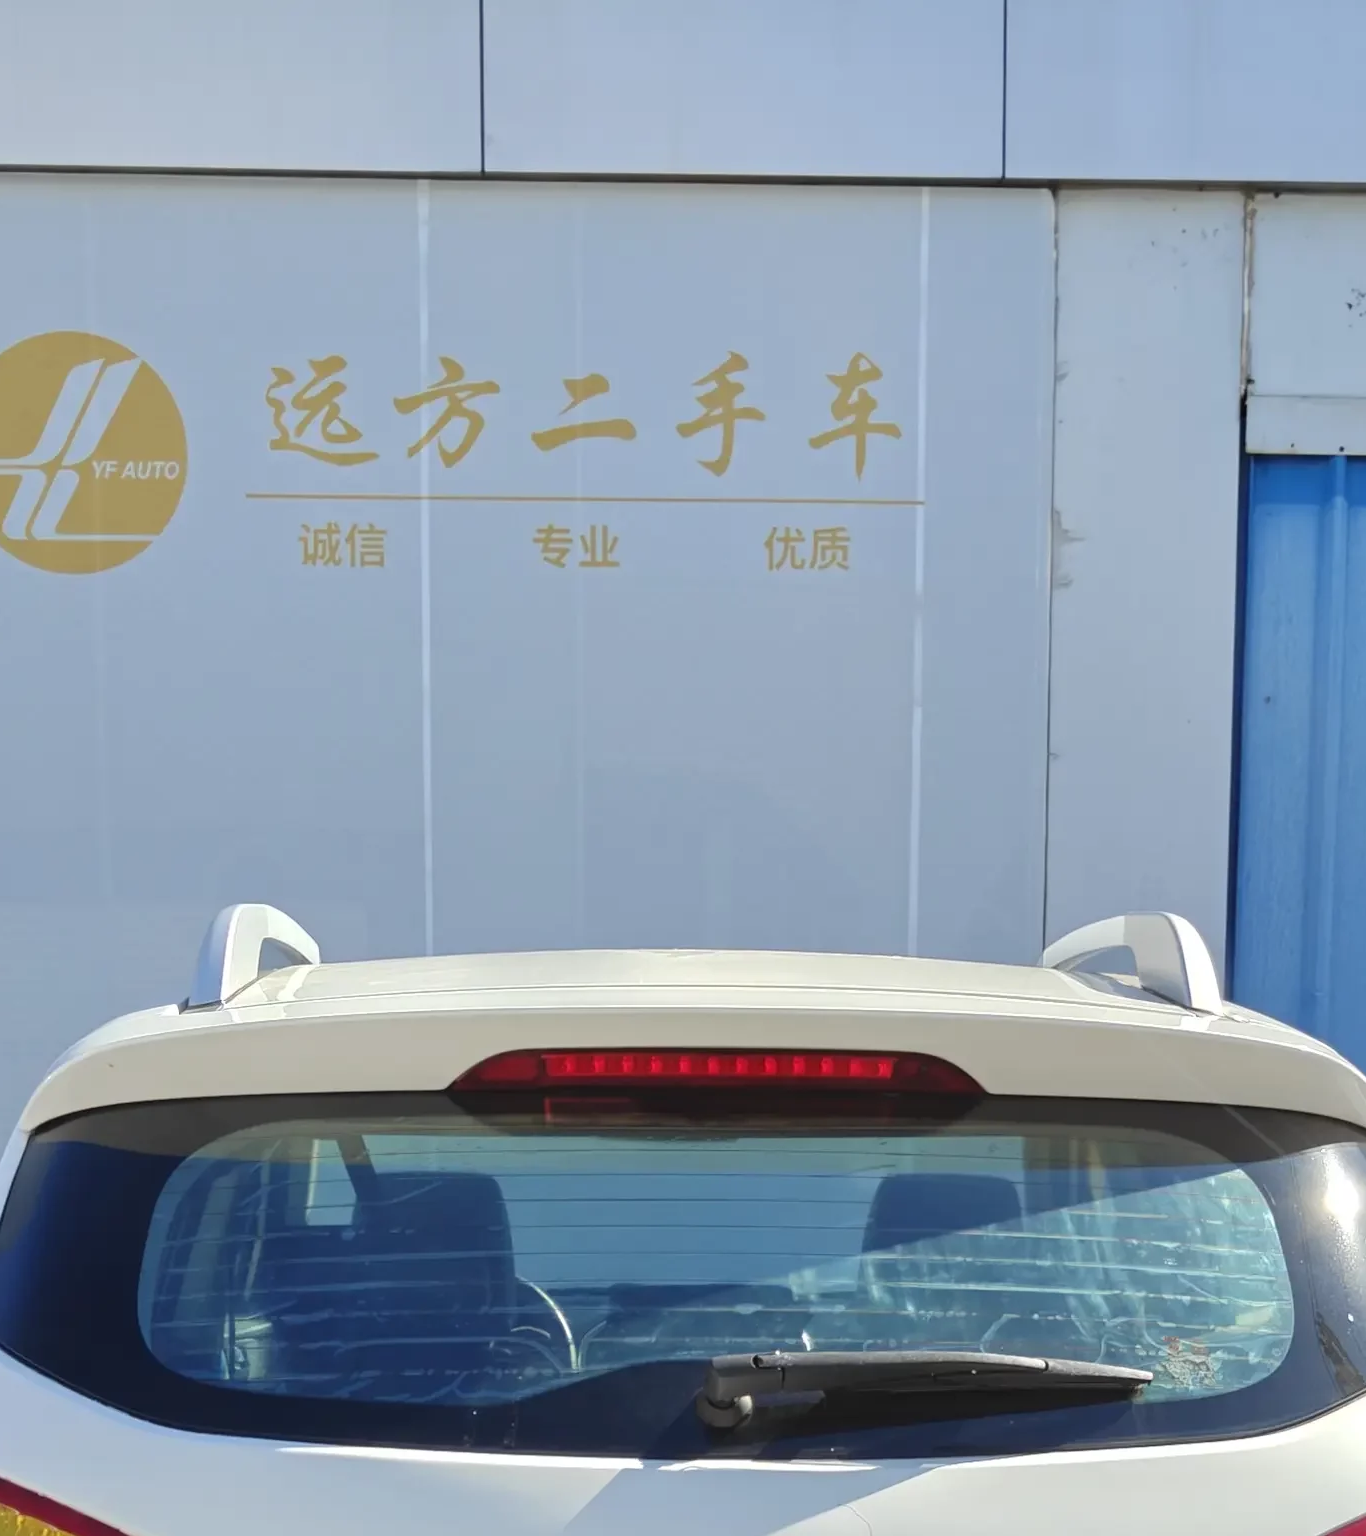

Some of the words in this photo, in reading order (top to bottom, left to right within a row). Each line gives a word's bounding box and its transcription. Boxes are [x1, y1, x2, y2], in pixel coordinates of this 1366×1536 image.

[265, 349, 903, 483] 远方二手车
[91, 460, 118, 480] YF
[120, 460, 180, 481] AUTO
[298, 522, 388, 569] 诚信
[532, 523, 622, 569] 专业
[763, 526, 852, 572] 优质
